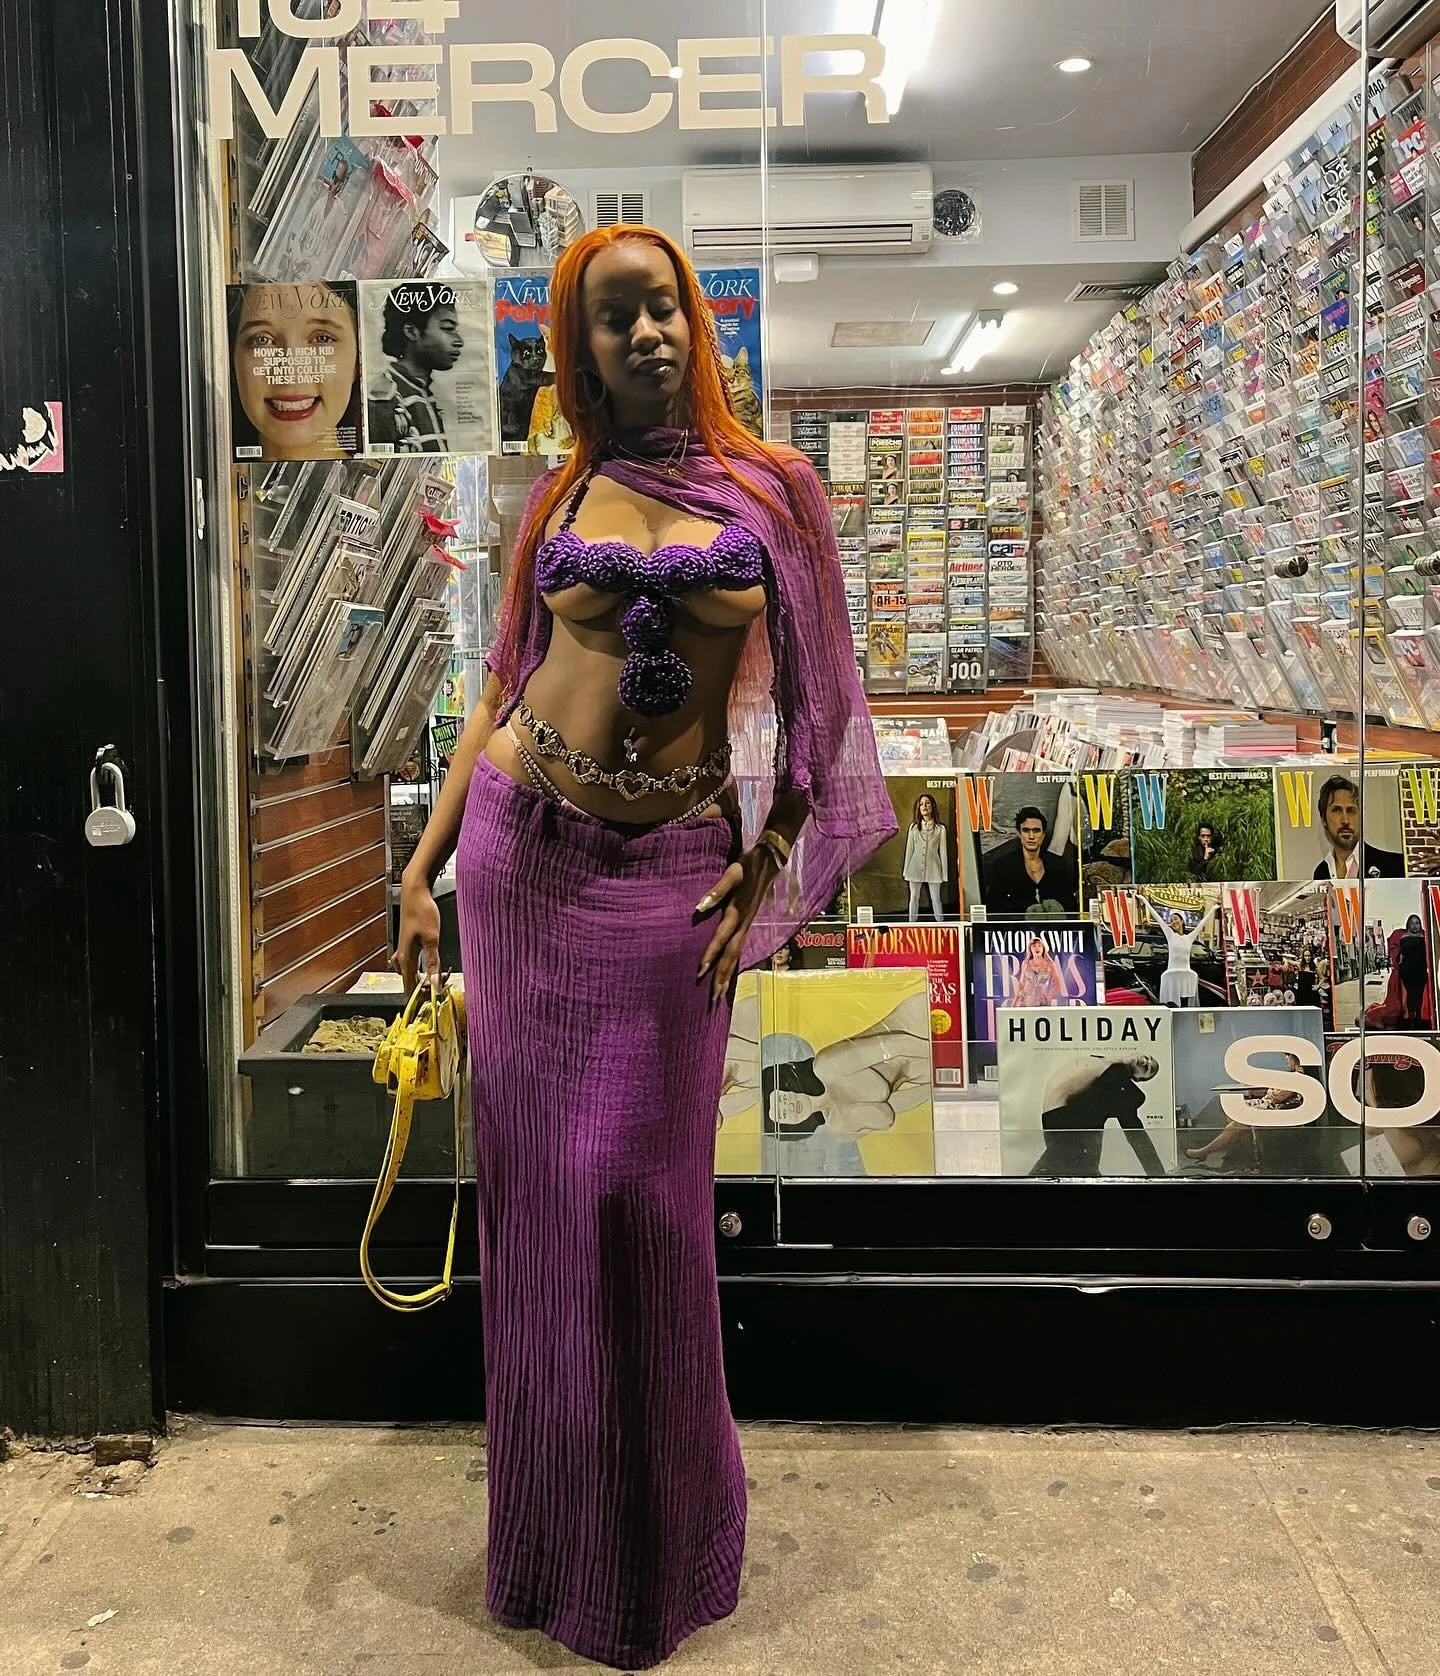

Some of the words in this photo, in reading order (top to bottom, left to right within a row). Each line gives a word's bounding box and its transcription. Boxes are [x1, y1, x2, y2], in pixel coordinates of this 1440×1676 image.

[207, 33, 891, 140] MERCER
[253, 347, 284, 358] HOW'S
[286, 347, 293, 357] A
[295, 346, 316, 357] RICH
[318, 345, 335, 356] KID
[263, 356, 311, 367] SUPPOSED
[313, 355, 326, 366] TO
[252, 366, 272, 376] GET
[273, 366, 295, 376] INTO
[297, 364, 337, 375] COLLEGE
[265, 375, 296, 385] THESE
[297, 373, 325, 384] DAYS?
[868, 528, 889, 536] BMW
[876, 595, 907, 607] AR-15
[927, 780, 942, 788] BEST
[1036, 775, 1051, 783] BEST
[963, 776, 996, 833] W
[1082, 774, 1117, 830] W
[1134, 773, 1168, 830] W
[1280, 771, 1314, 828] W
[1102, 889, 1138, 949] W
[1226, 887, 1262, 947] W
[850, 927, 903, 955] TAYLOR
[905, 927, 958, 955] SWIFT
[1009, 1017, 1162, 1042] HOLIDAY
[1220, 1034, 1440, 1128] SO
